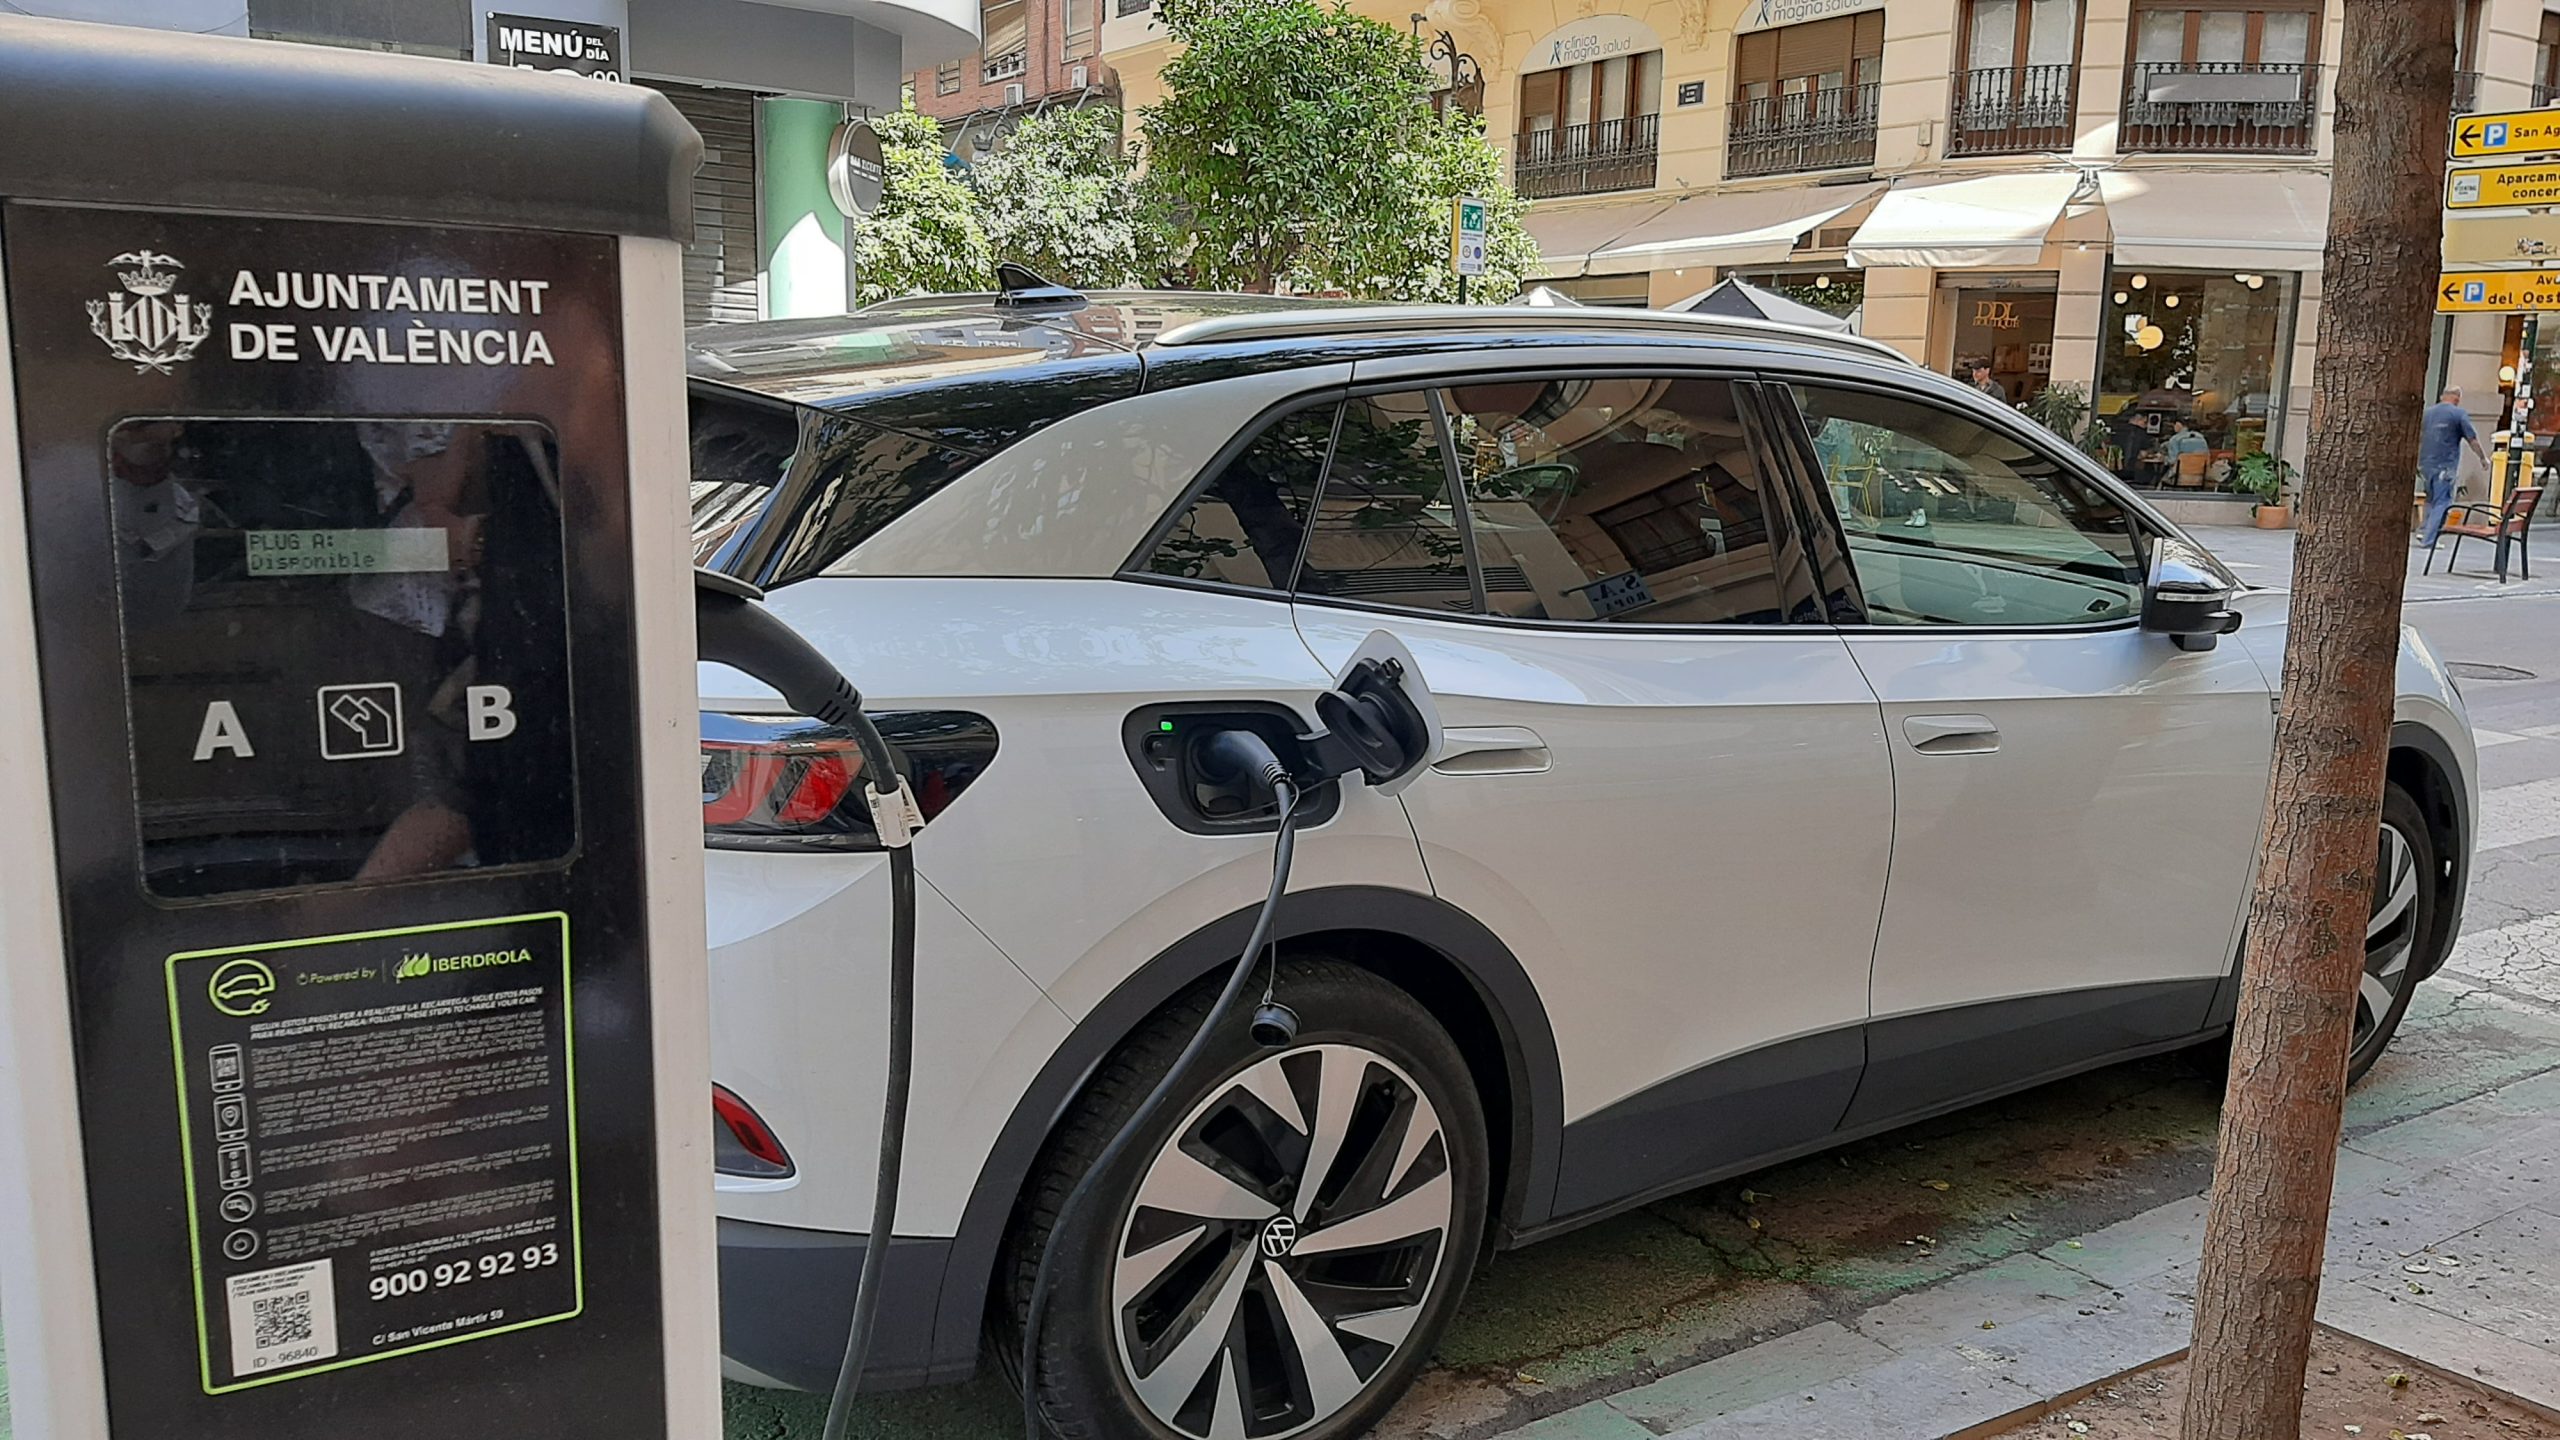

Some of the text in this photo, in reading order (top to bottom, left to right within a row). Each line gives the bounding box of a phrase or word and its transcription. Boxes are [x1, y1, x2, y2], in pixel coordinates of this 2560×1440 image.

[1774, 2, 1822, 20] magna
[500, 27, 609, 61] MENÚ DEL DÍA
[1564, 37, 1631, 61] magna salud
[2514, 127, 2539, 138] San
[2497, 173, 2560, 186] Aparcam
[229, 270, 548, 314] AJUNTAMENT
[2488, 292, 2513, 304] del
[1976, 301, 2019, 320] DDL
[229, 320, 555, 366] DE VALÈNCIA
[250, 533, 334, 550] PLUG A:
[251, 552, 375, 570] Disponible
[466, 685, 517, 742] B
[193, 701, 255, 761] A
[310, 948, 532, 983] Powered by IBERDROLA
[369, 1269, 428, 1300] 900
[434, 1260, 472, 1287] 92
[478, 1251, 516, 1278] 92
[522, 1243, 559, 1269] 93
[387, 1330, 410, 1343] San
[412, 1320, 453, 1338] Vicente
[456, 1312, 488, 1329] Mártir
[253, 1356, 267, 1368] ID
[278, 1346, 318, 1363] 96840
